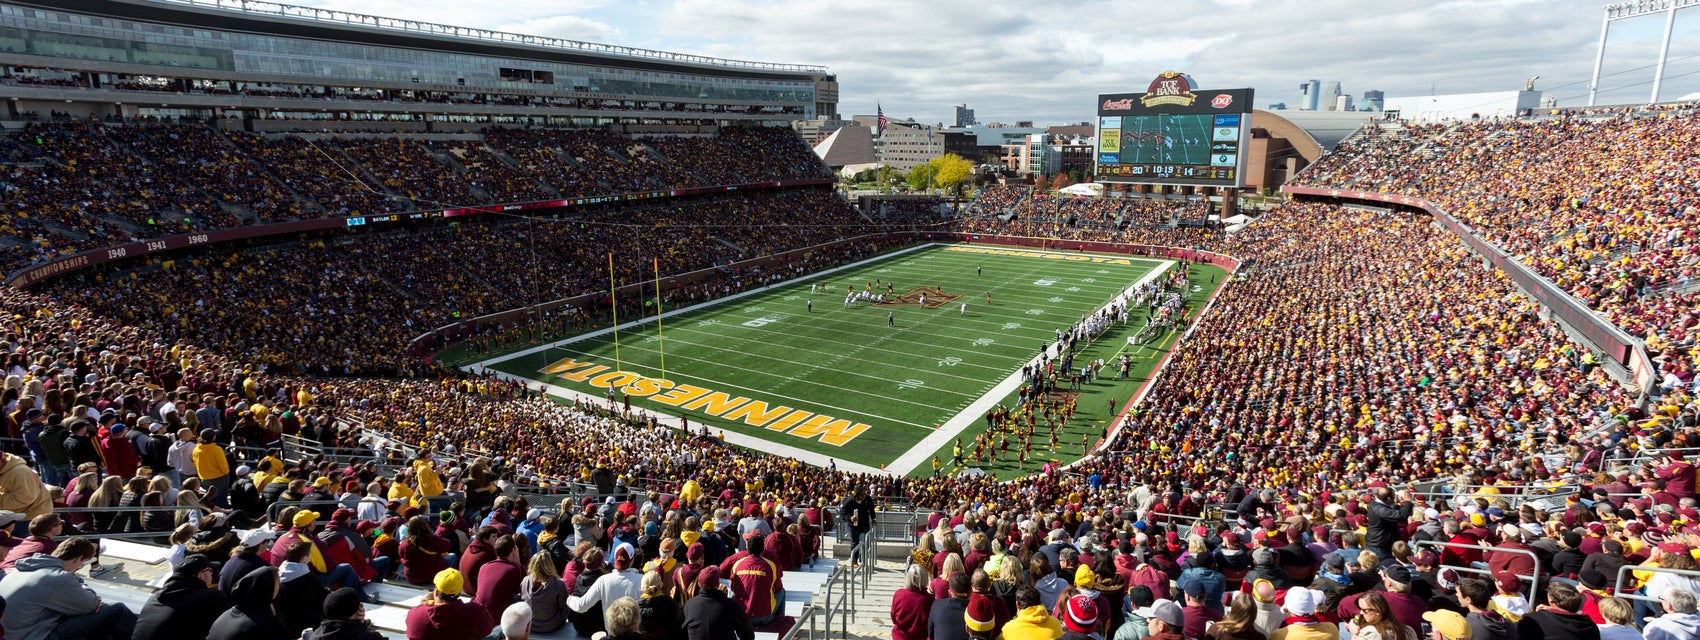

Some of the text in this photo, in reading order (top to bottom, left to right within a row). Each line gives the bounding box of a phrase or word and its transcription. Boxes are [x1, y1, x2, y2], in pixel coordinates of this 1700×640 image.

[1161, 80, 1178, 90] TCF
[1157, 86, 1180, 96] BANK
[1132, 166, 1143, 175] 20
[1153, 165, 1173, 173] 10:19
[1184, 167, 1193, 176] 14
[107, 247, 127, 259] 1940
[147, 240, 167, 251] 1941
[188, 234, 208, 245] 1960
[945, 246, 1131, 265] MINNESOTA
[537, 357, 872, 447] MINNESOTA
